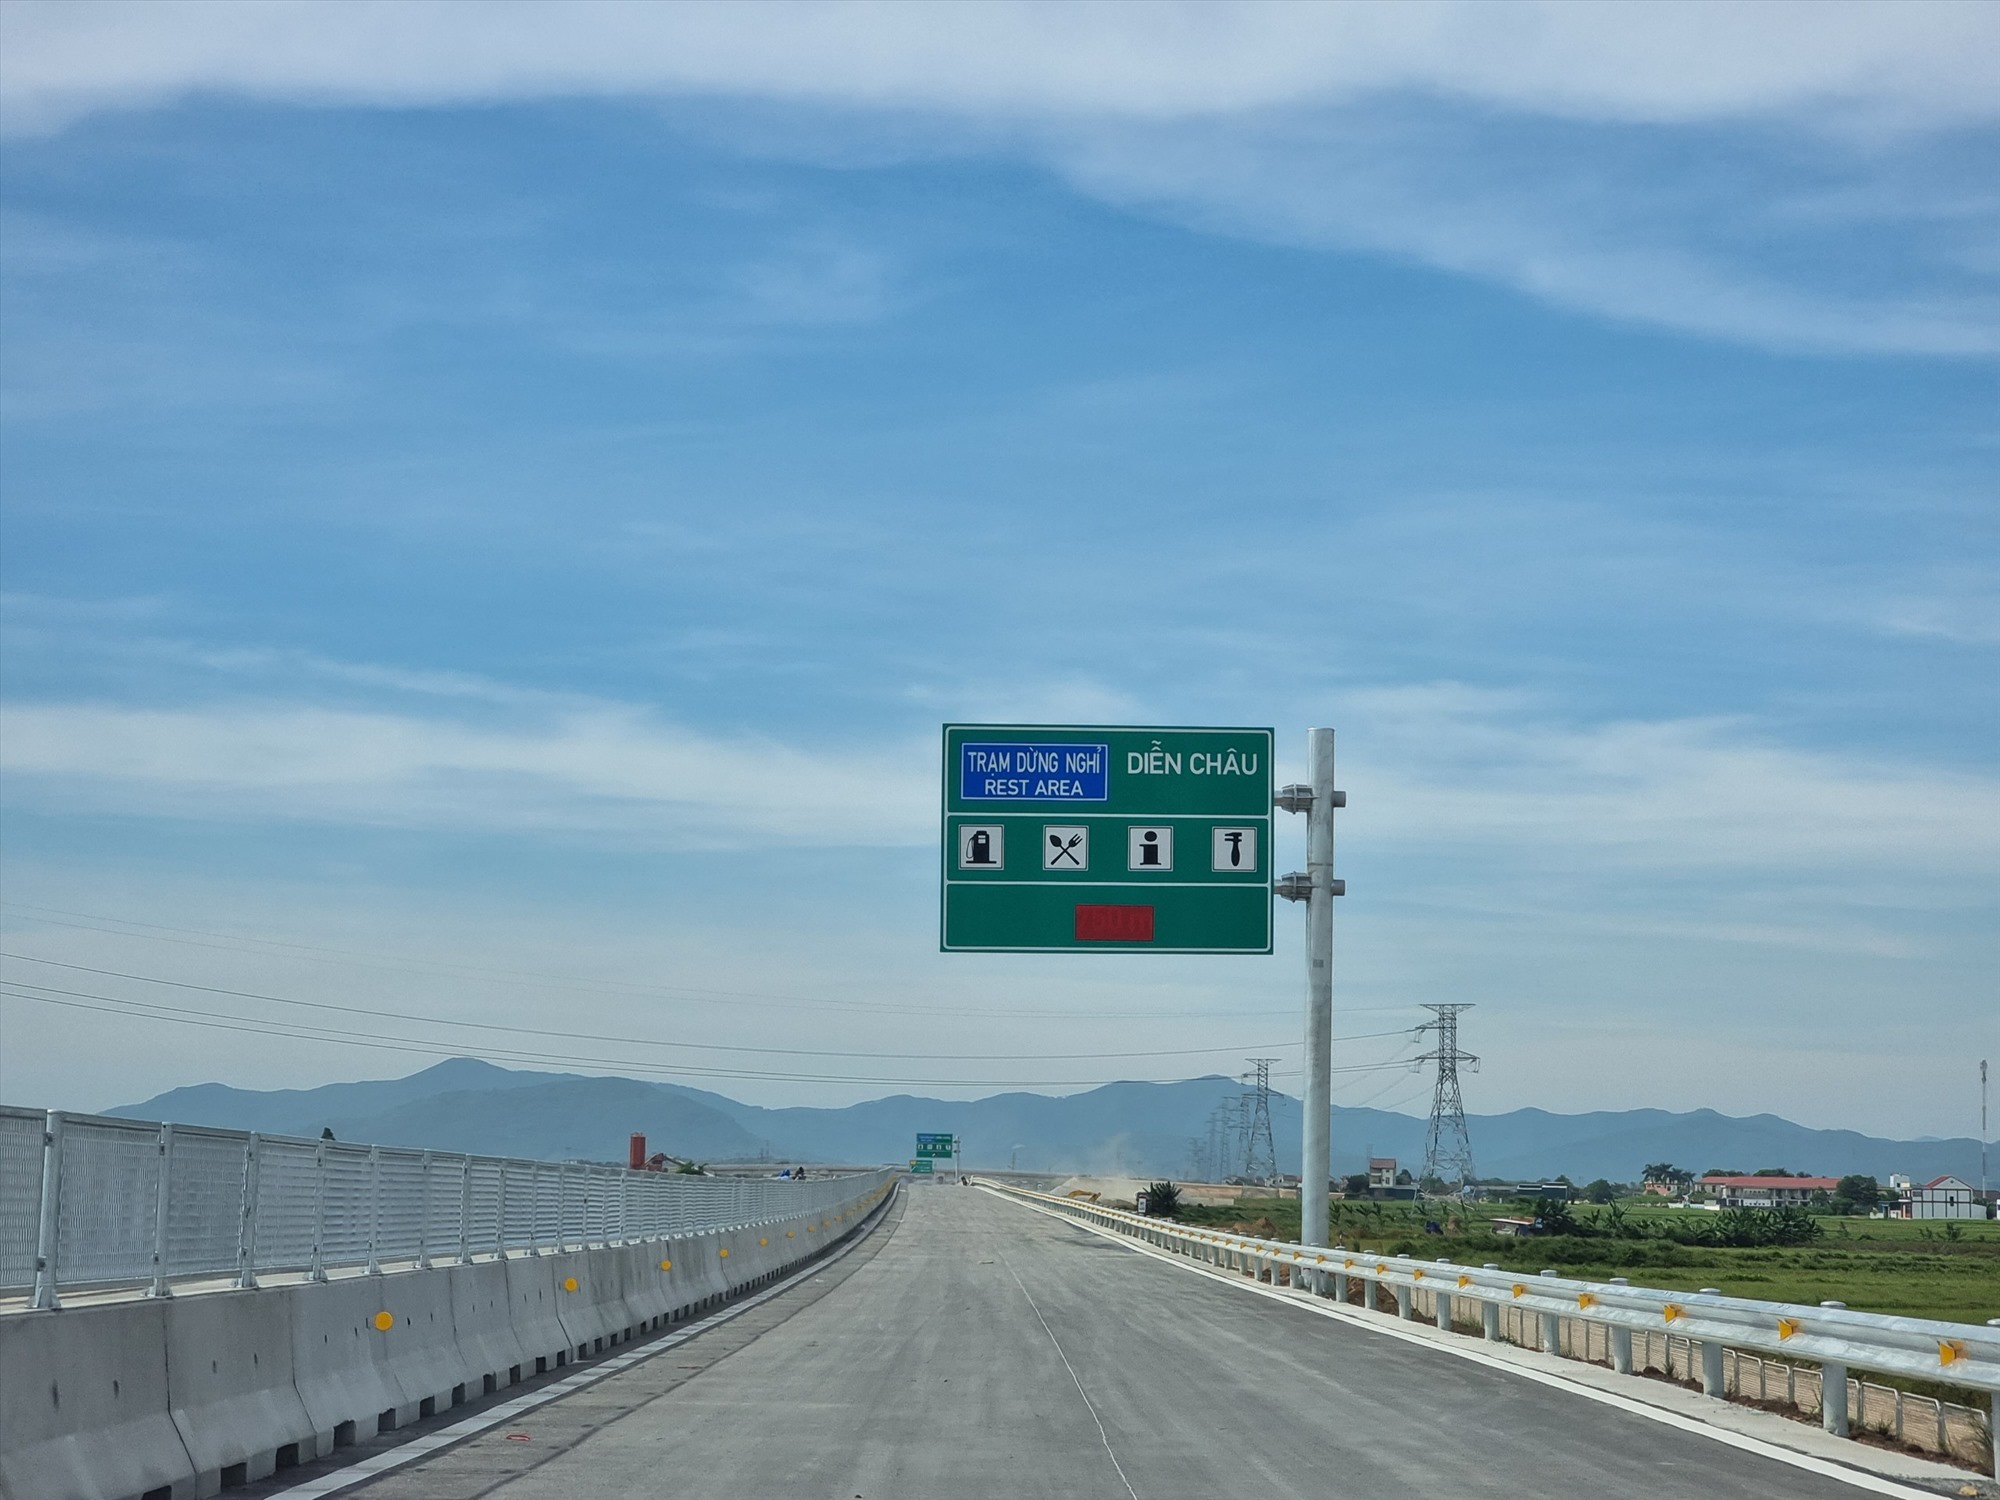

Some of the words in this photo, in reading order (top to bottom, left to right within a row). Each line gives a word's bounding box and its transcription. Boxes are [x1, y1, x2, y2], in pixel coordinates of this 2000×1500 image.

[968, 752, 1010, 776] TRẠM
[1017, 747, 1059, 773] DỪNG
[1066, 746, 1102, 774] NGHỈ
[1127, 740, 1182, 775] DIỄN
[1189, 747, 1258, 775] CHÂU
[985, 779, 1030, 796] REST
[1035, 780, 1084, 796] AREA
